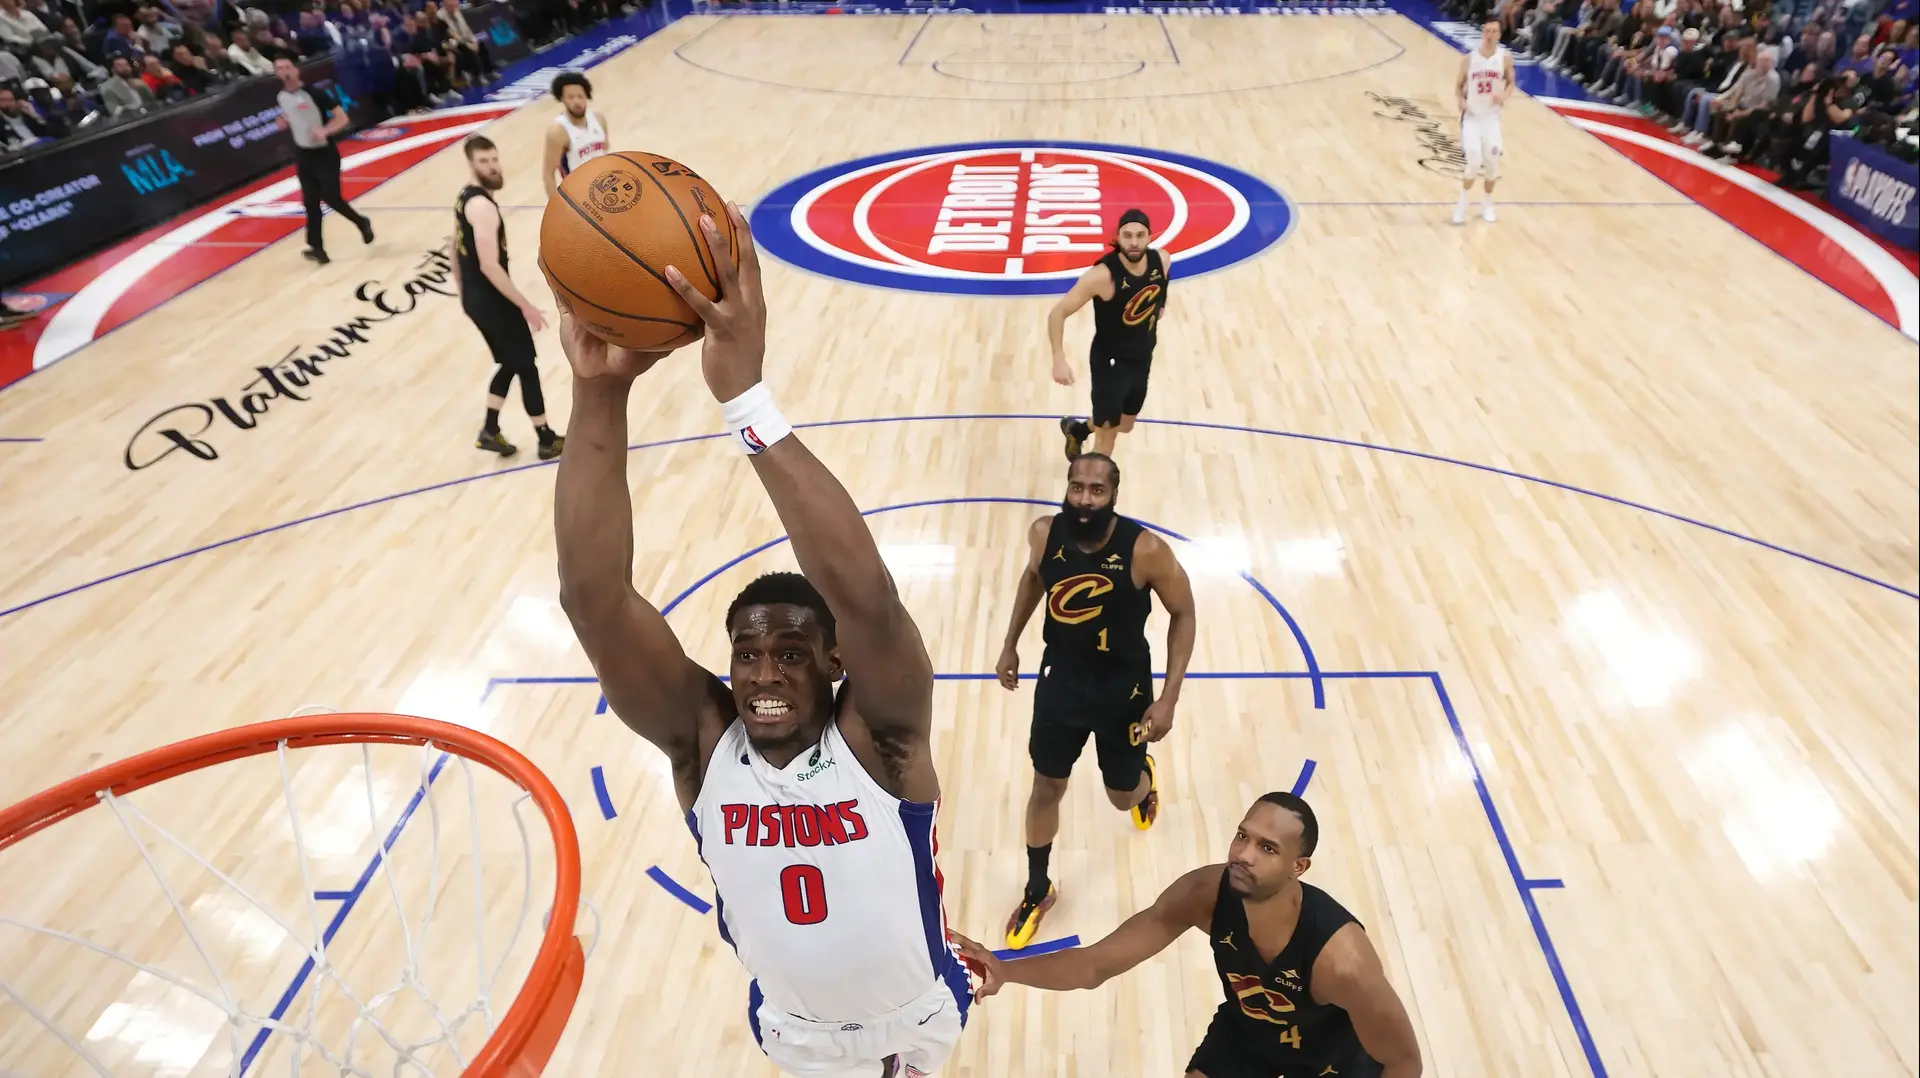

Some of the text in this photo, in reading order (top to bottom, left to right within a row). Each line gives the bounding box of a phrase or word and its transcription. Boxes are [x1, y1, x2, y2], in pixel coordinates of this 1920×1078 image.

[1477, 81, 1493, 94] 55
[927, 164, 1020, 255] DETROIT
[1022, 163, 1105, 254] PISTONS
[1849, 163, 1916, 225] PLAYOFFS
[124, 237, 459, 470] Platinum Equit
[1101, 563, 1124, 571] CLIFFS
[1048, 573, 1114, 625] C
[1096, 627, 1110, 652] 1
[721, 798, 869, 848] PISTONS
[780, 863, 828, 926] 0
[1275, 976, 1303, 992] CLIFFS
[1279, 1024, 1303, 1050] 4
